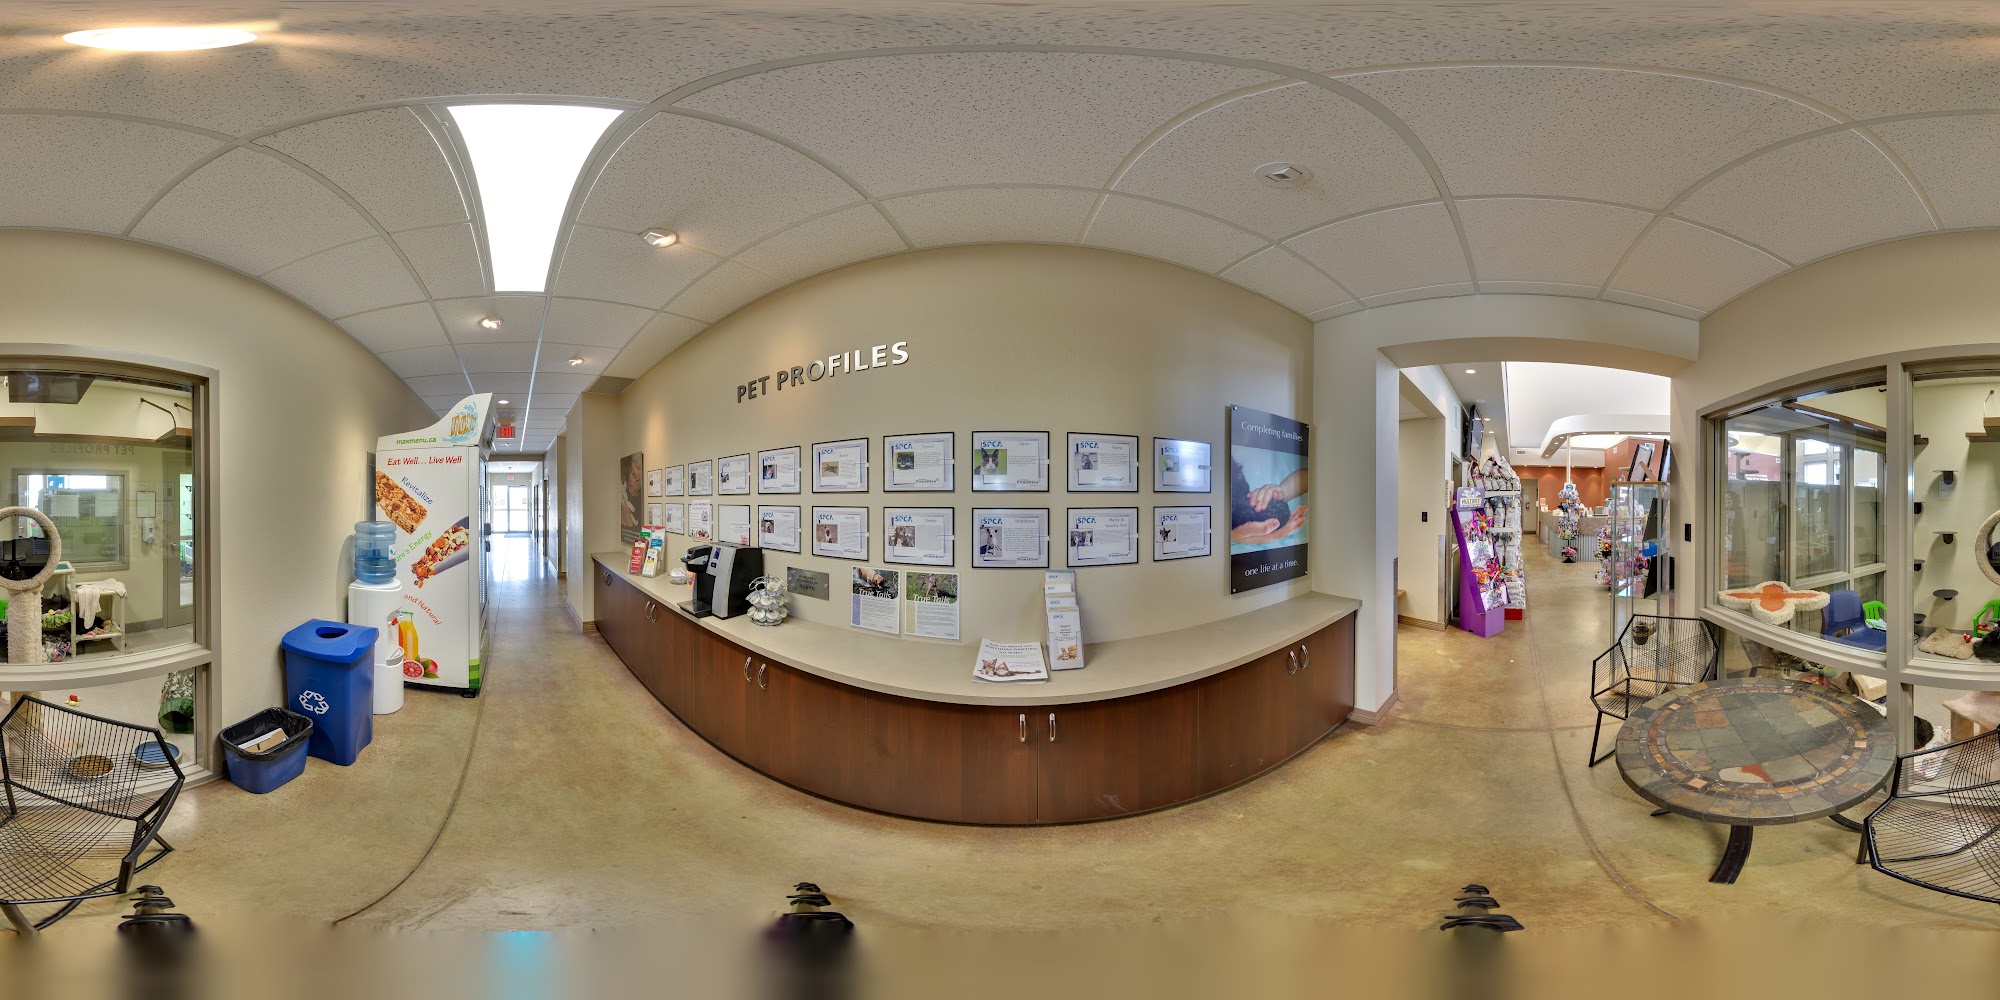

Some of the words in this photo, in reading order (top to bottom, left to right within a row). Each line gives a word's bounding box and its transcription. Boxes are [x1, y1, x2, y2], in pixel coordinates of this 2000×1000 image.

[737, 376, 770, 403] PET
[776, 342, 909, 390] PROFILES
[499, 427, 513, 438] EXIT
[1242, 421, 1281, 439] Completing
[1282, 429, 1303, 442] families
[388, 457, 401, 466] Eat
[429, 456, 444, 464] Live
[446, 456, 462, 464] Well
[401, 476, 433, 505] Revitalize
[409, 530, 432, 550] Energy
[1245, 567, 1258, 577] one
[1260, 563, 1270, 574] life
[1284, 560, 1298, 568] time.
[859, 588, 874, 596] True
[876, 590, 892, 599] Tails
[913, 594, 930, 602] True
[932, 596, 950, 604] Tails
[403, 594, 417, 604] and
[418, 600, 442, 626] Natural
